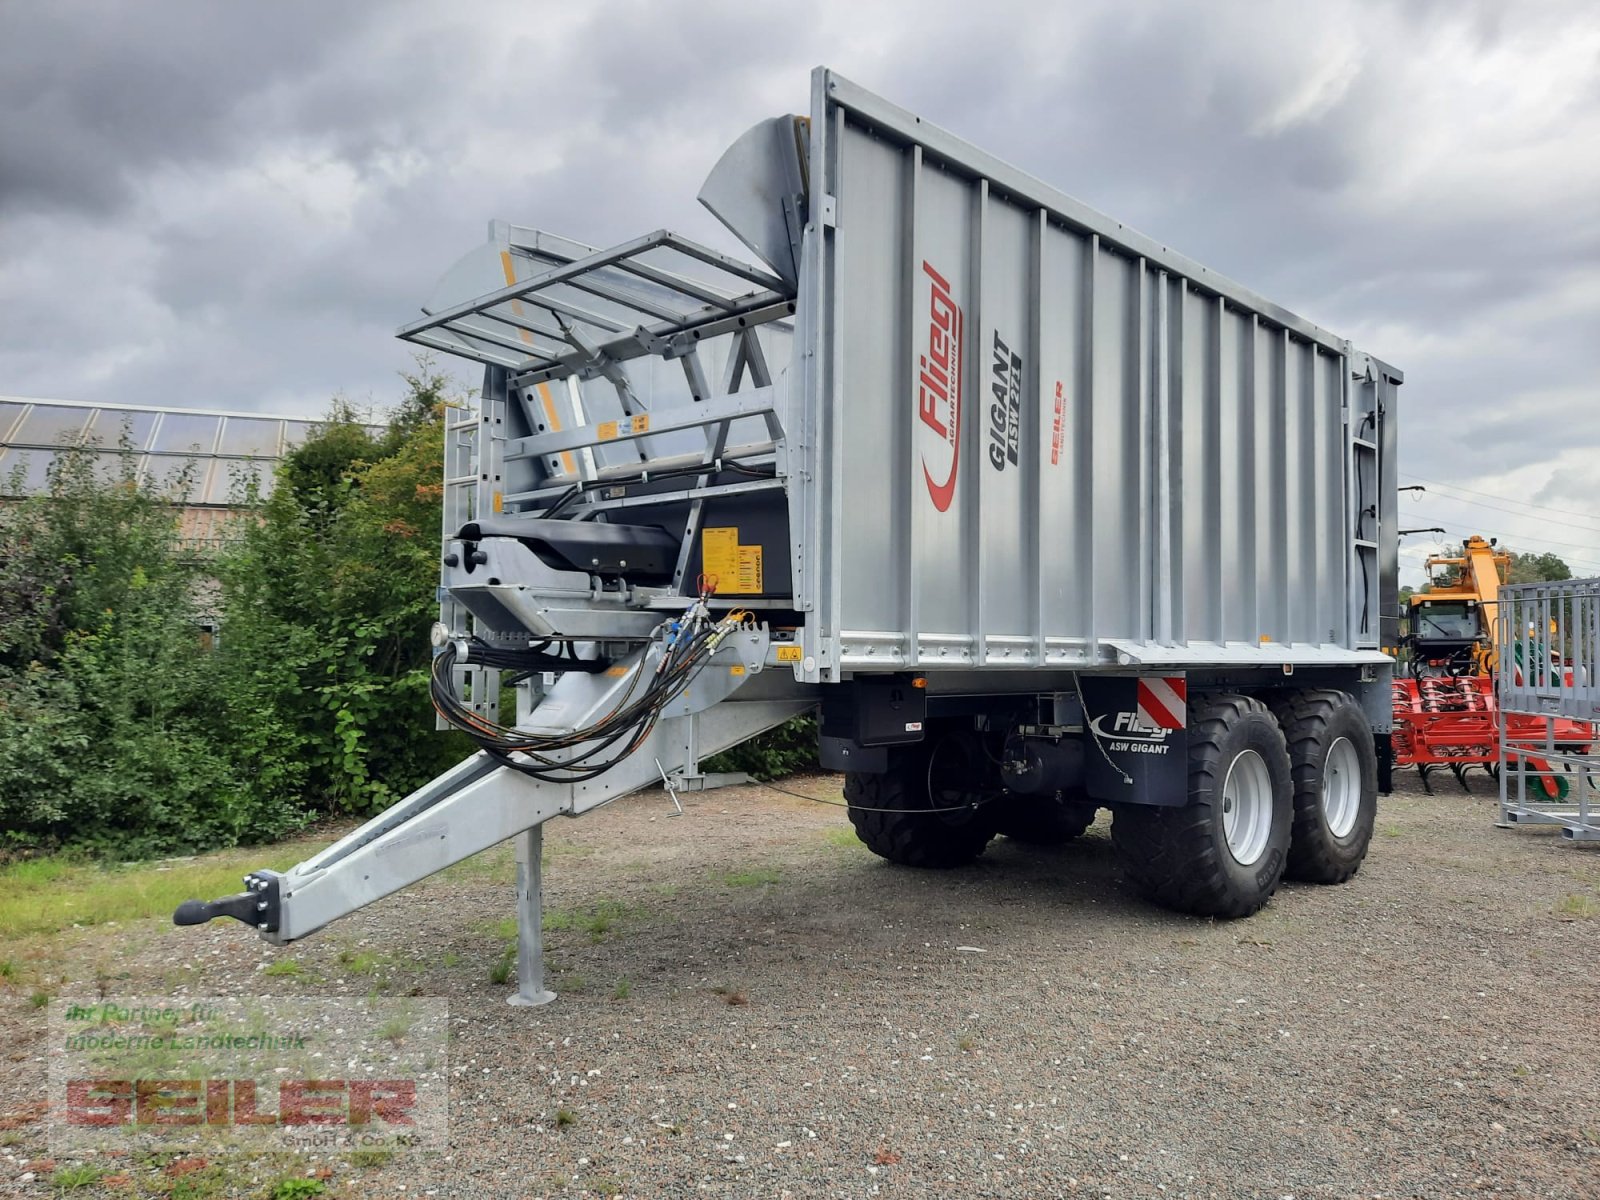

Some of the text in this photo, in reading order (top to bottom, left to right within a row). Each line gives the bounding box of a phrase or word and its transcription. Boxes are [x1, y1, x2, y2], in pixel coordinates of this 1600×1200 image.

[919, 259, 957, 440] Fliegl
[949, 342, 957, 449] AGRARTECHNIK
[989, 328, 1009, 472] GIGANT
[1007, 365, 1021, 453] ASW 271
[1050, 380, 1063, 466] SEILER
[1109, 741, 1170, 755] ASW GIGANT
